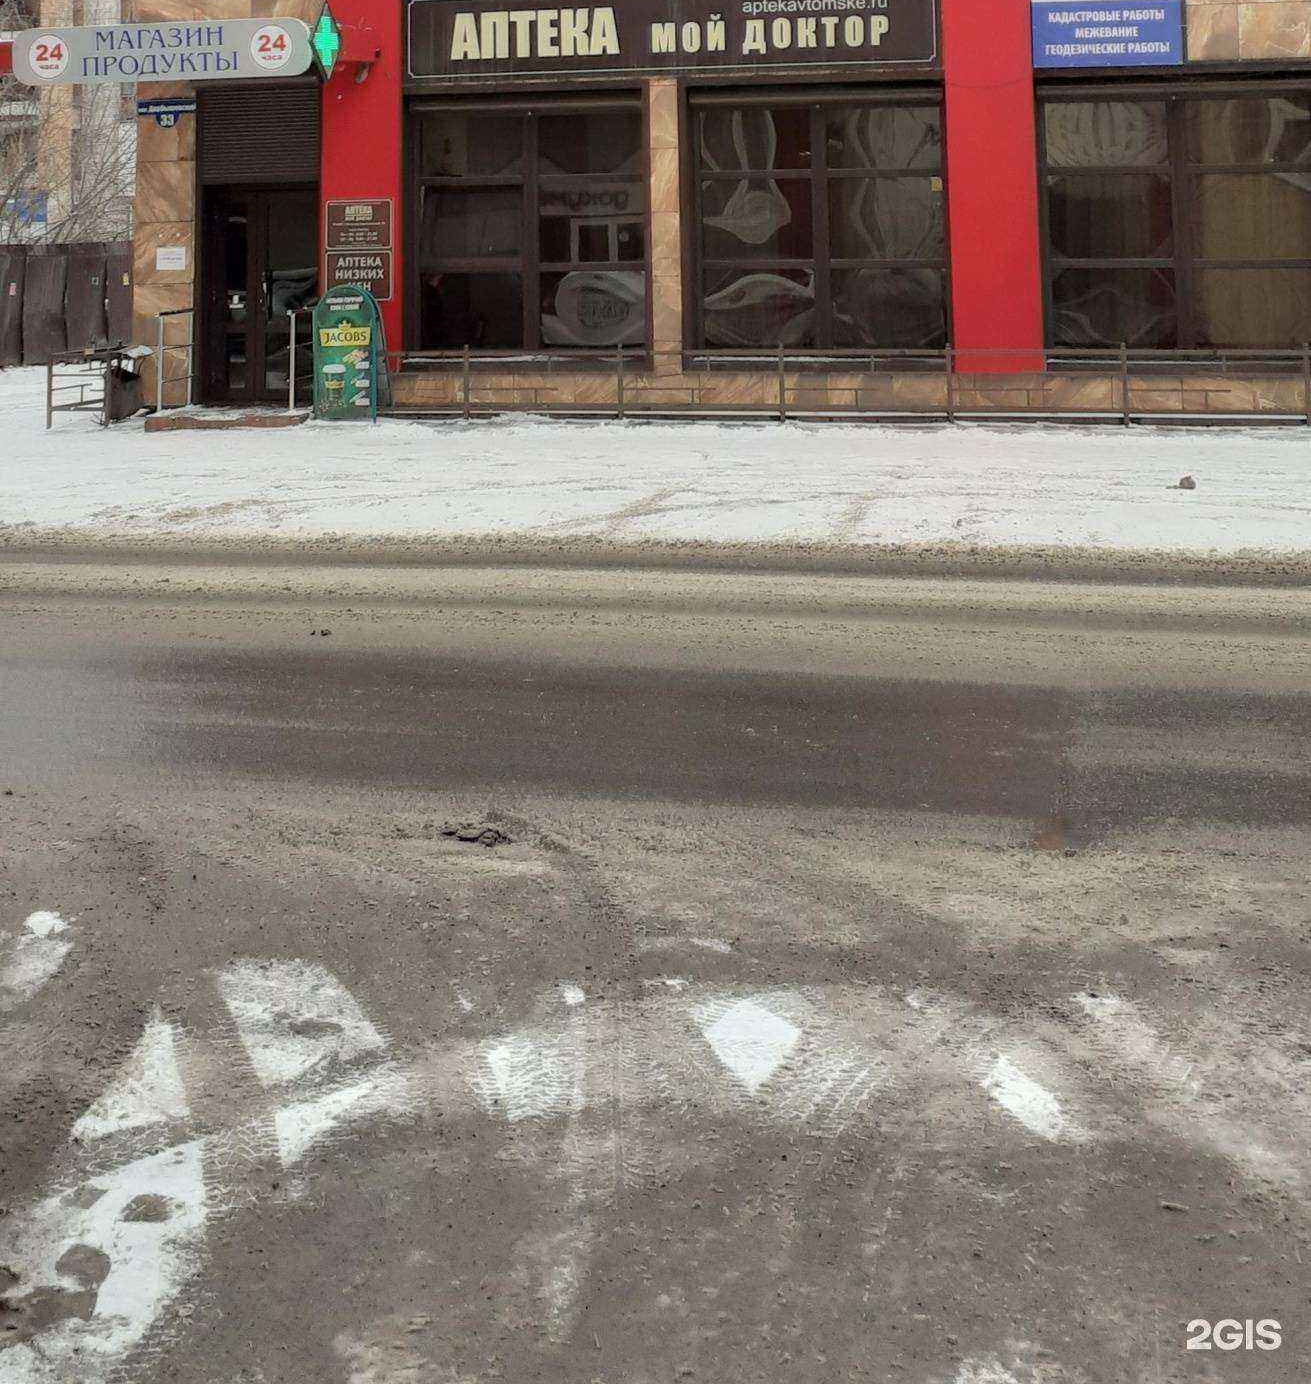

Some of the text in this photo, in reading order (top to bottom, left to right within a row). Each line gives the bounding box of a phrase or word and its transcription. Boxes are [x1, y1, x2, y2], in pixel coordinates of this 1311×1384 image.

[1048, 9, 1165, 24] КАДАСТРОВЫЕ РАБОТЫ
[95, 26, 225, 52] МАГАЗИН
[450, 6, 890, 60] АПТЕКА МОЙ ДОКТОР
[1075, 26, 1139, 39] МЕЖЕВАНИЕ
[258, 34, 287, 52] 24
[1045, 42, 1170, 57] ГЕОДЕЗИЧЕСКИЕ РАБОТЫ
[36, 43, 63, 61] 24
[82, 50, 240, 77] ПРОДУКТЫ
[337, 256, 383, 268] АПТЕКА
[335, 268, 385, 281] НИЗКИХ
[324, 330, 367, 344] JACOBS
